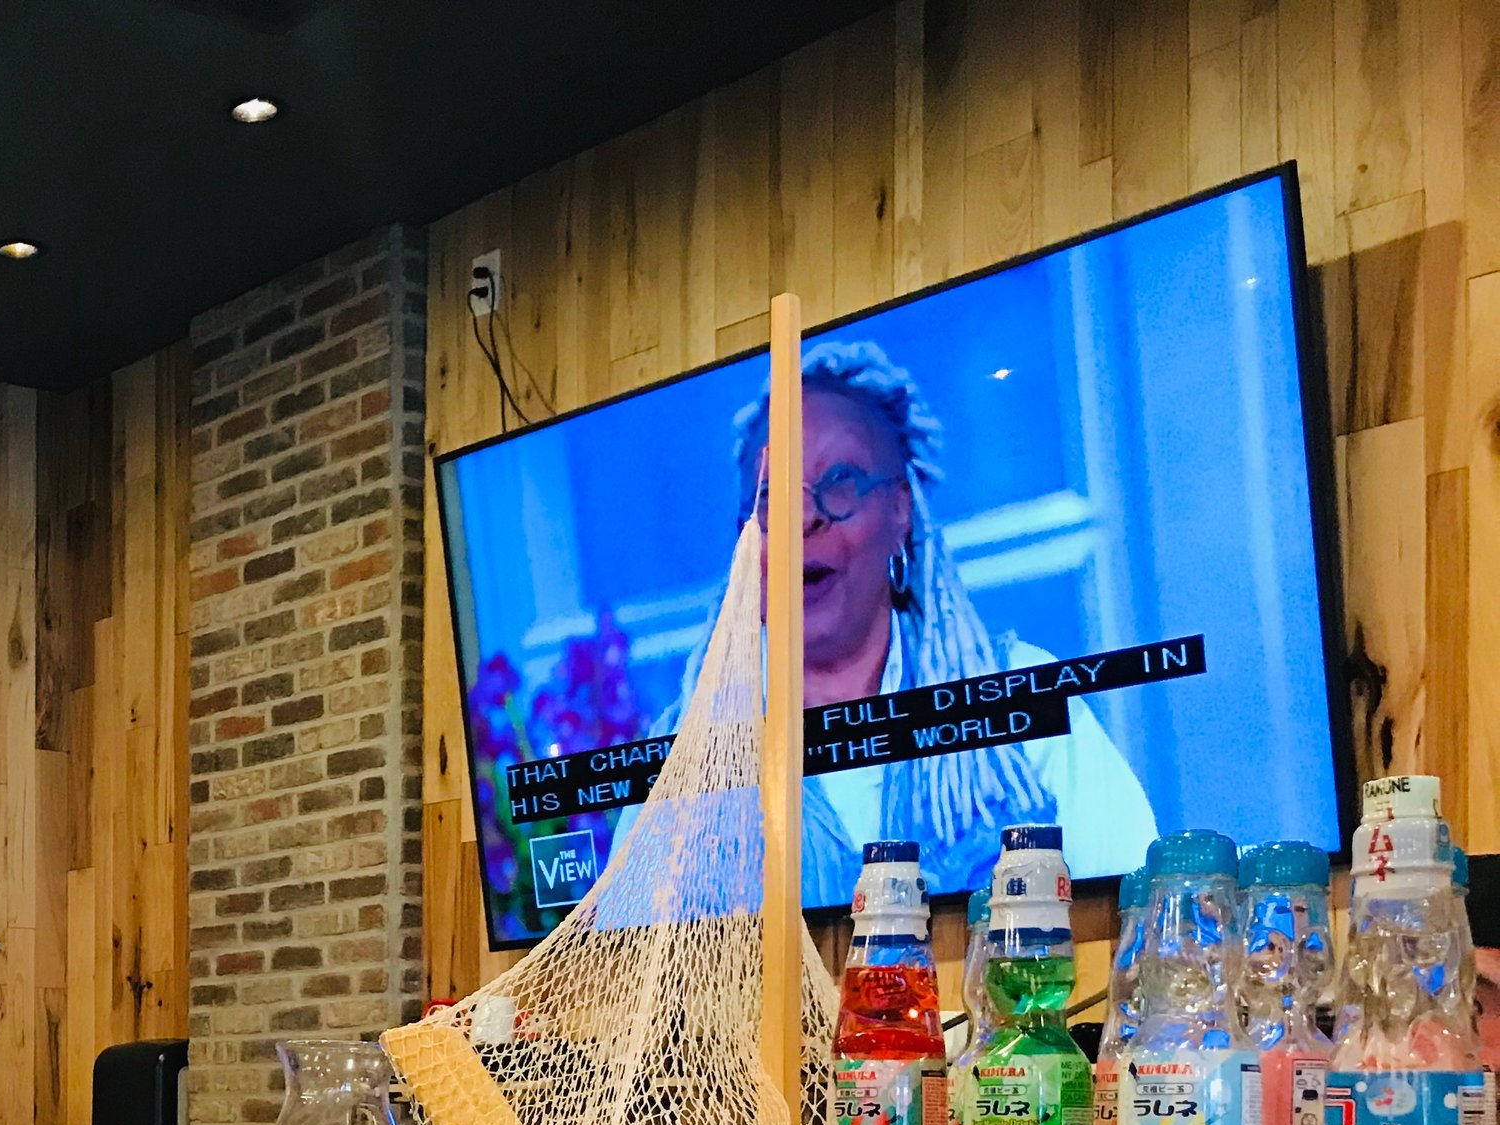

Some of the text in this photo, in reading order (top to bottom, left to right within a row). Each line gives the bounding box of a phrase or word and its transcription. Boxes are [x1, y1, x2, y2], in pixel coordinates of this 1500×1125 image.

[509, 759, 571, 788] THAT
[823, 699, 909, 731] FULL
[934, 658, 1106, 711] DISPLAY
[1143, 644, 1188, 674] IN
[510, 793, 561, 817] HIS
[577, 779, 631, 806] NEW
[913, 711, 1032, 750] WORLD
[1365, 777, 1411, 798] RAMUNE
[559, 849, 577, 860] THE
[834, 1102, 881, 1117] ラムネ
[976, 1100, 1030, 1116] ラムネ
[1133, 1099, 1198, 1117] ラムネ
